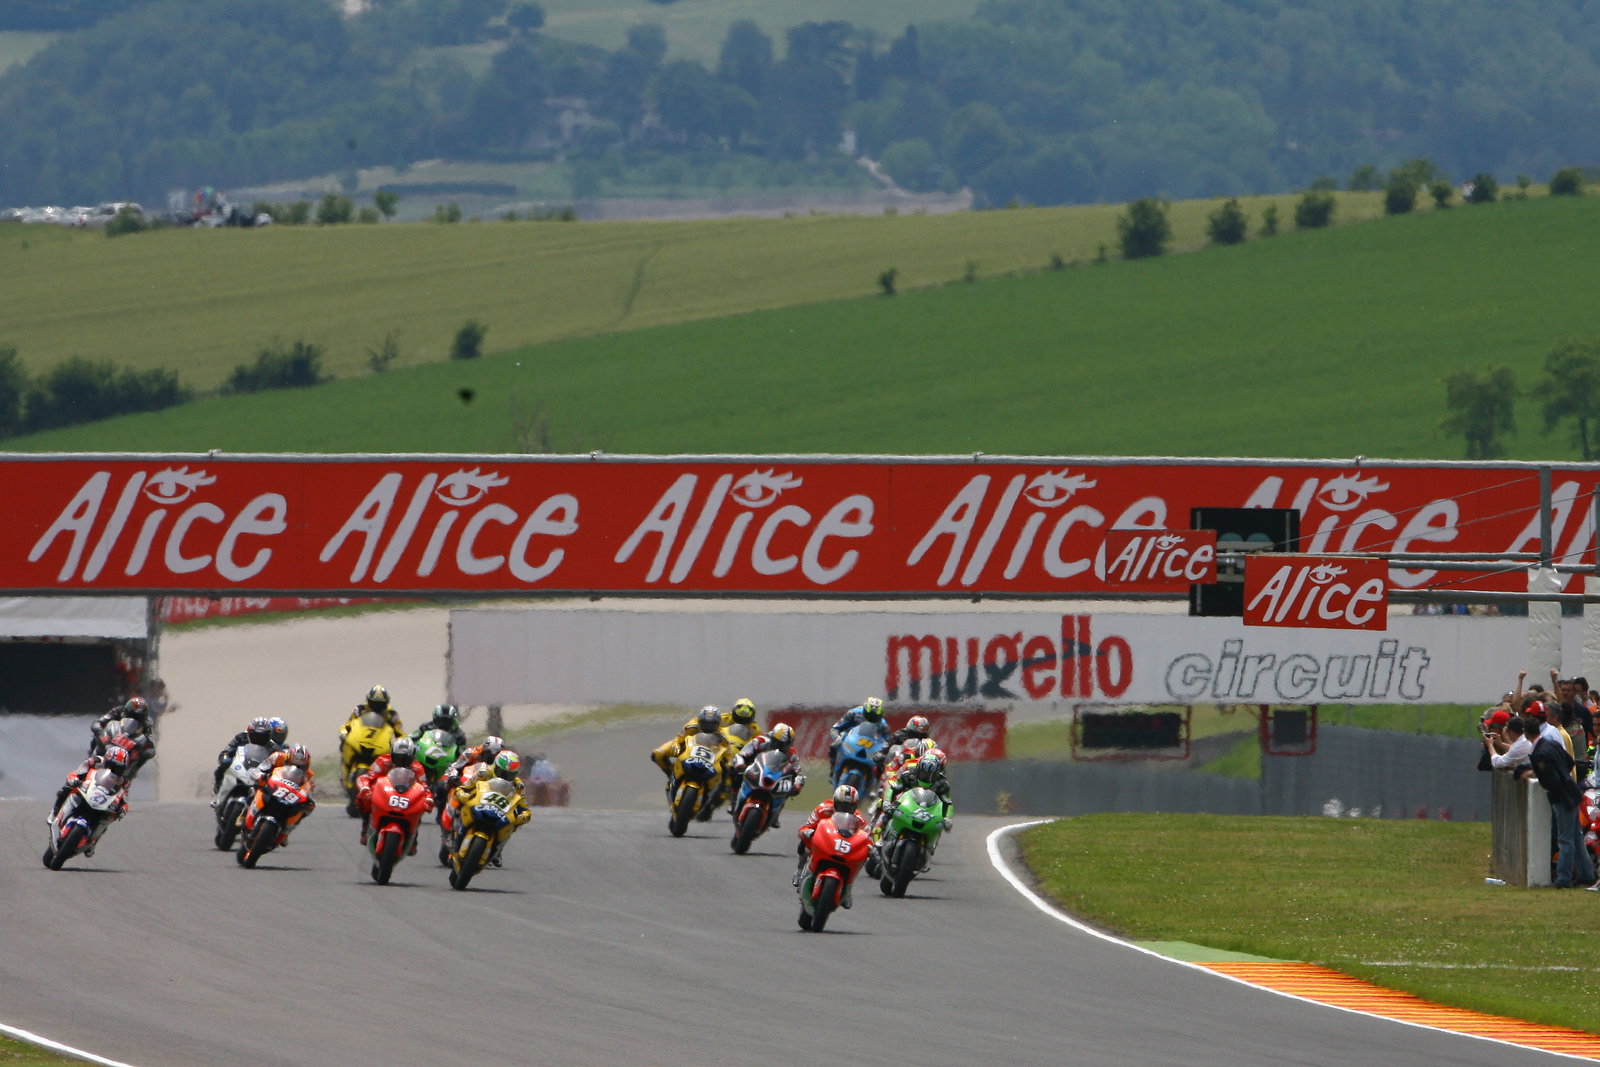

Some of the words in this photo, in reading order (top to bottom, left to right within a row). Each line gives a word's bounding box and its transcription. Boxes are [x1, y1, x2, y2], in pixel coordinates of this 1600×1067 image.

[28, 466, 287, 582] Alice
[320, 467, 579, 583] Alice
[614, 468, 874, 585] Alice
[1107, 533, 1214, 583] Alice
[1247, 562, 1384, 625] Alice
[885, 614, 1134, 702] mugello
[1165, 638, 1431, 702] circuit
[272, 785, 300, 804] 69
[388, 795, 410, 810] 65
[474, 804, 507, 823] CAMEL
[833, 837, 851, 855] 15
